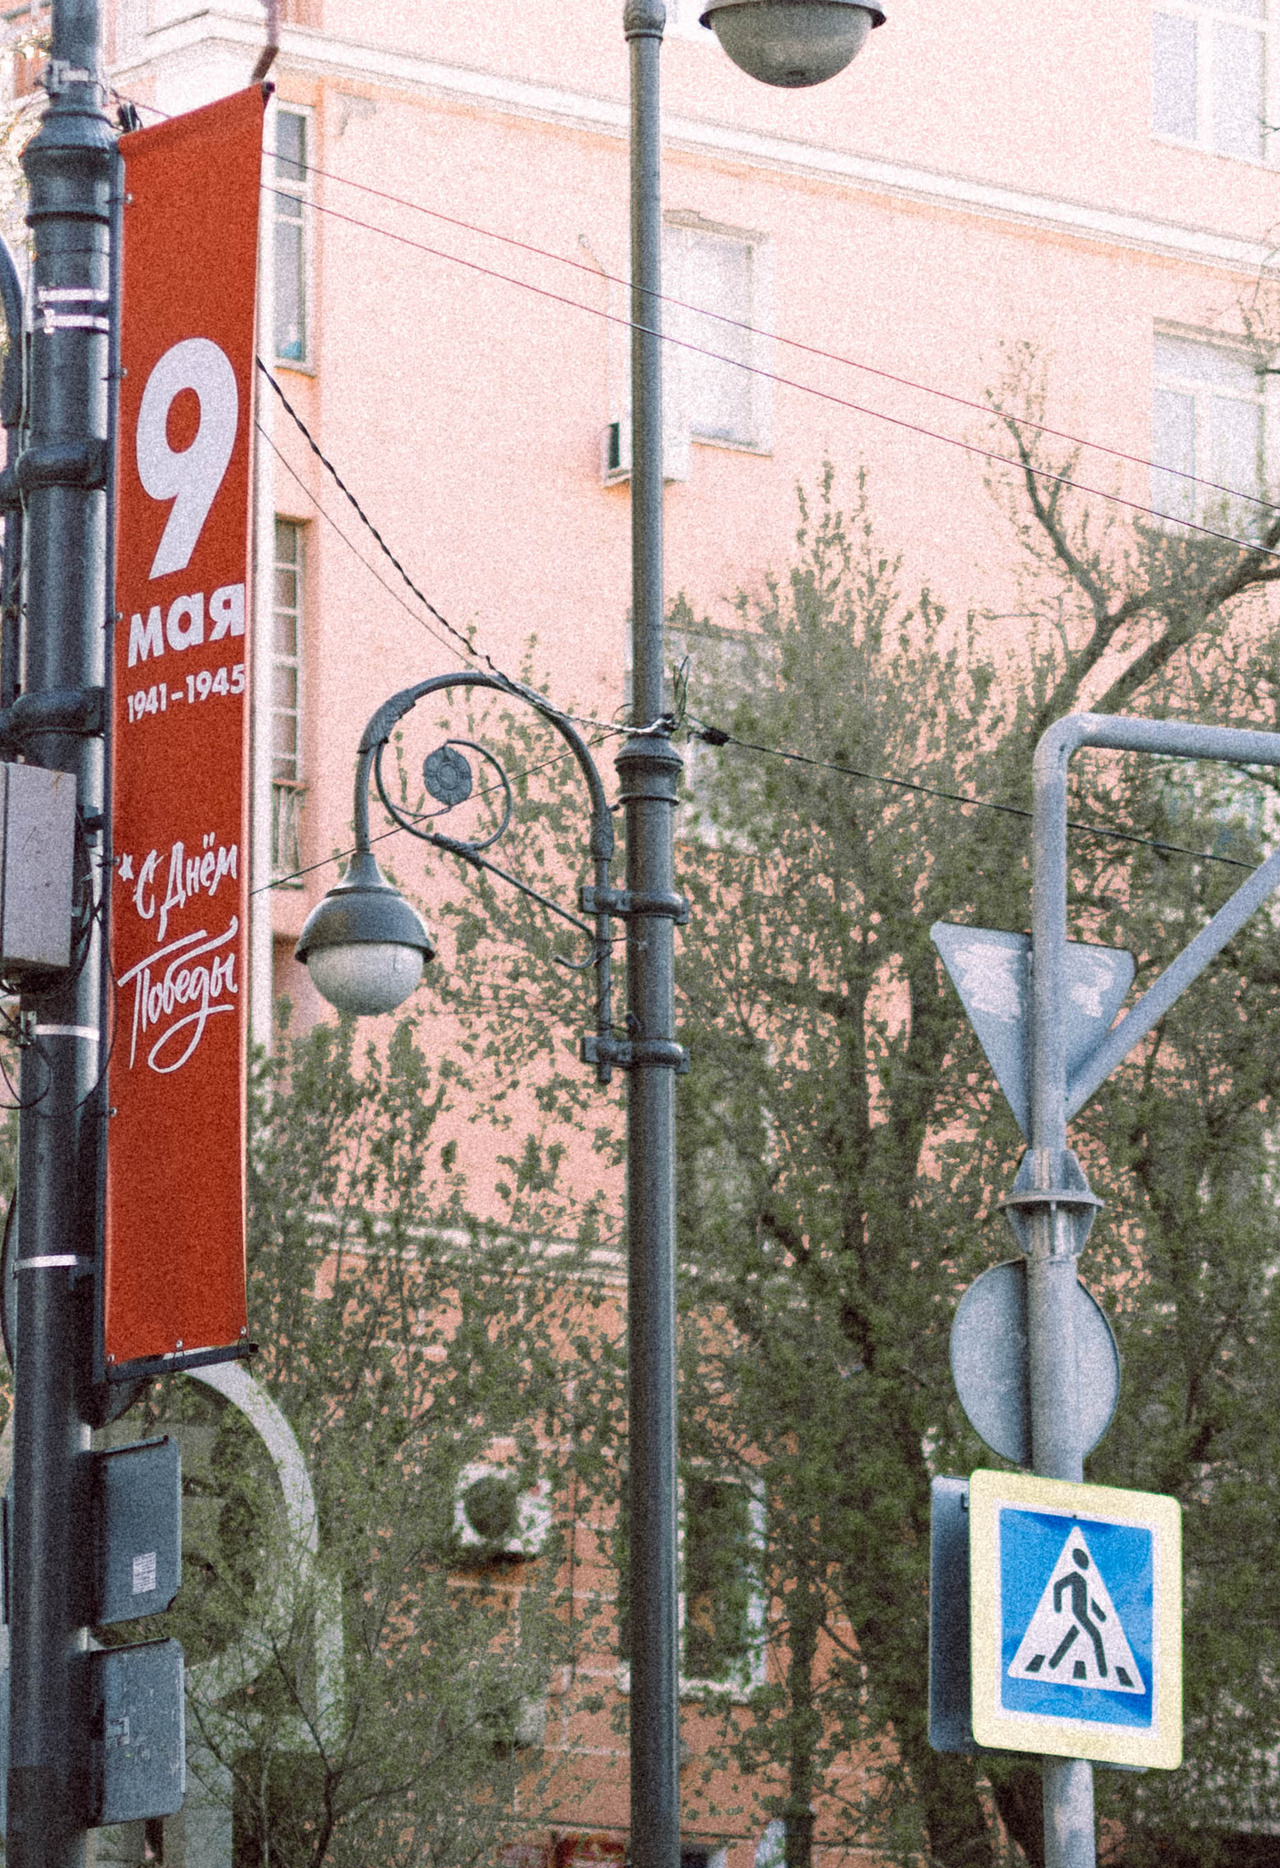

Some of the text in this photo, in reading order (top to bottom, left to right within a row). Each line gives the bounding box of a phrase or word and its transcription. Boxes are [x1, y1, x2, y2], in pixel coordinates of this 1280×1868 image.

[136, 337, 239, 580] 9
[133, 832, 237, 942] С Днём
[117, 915, 238, 1073] Победы
